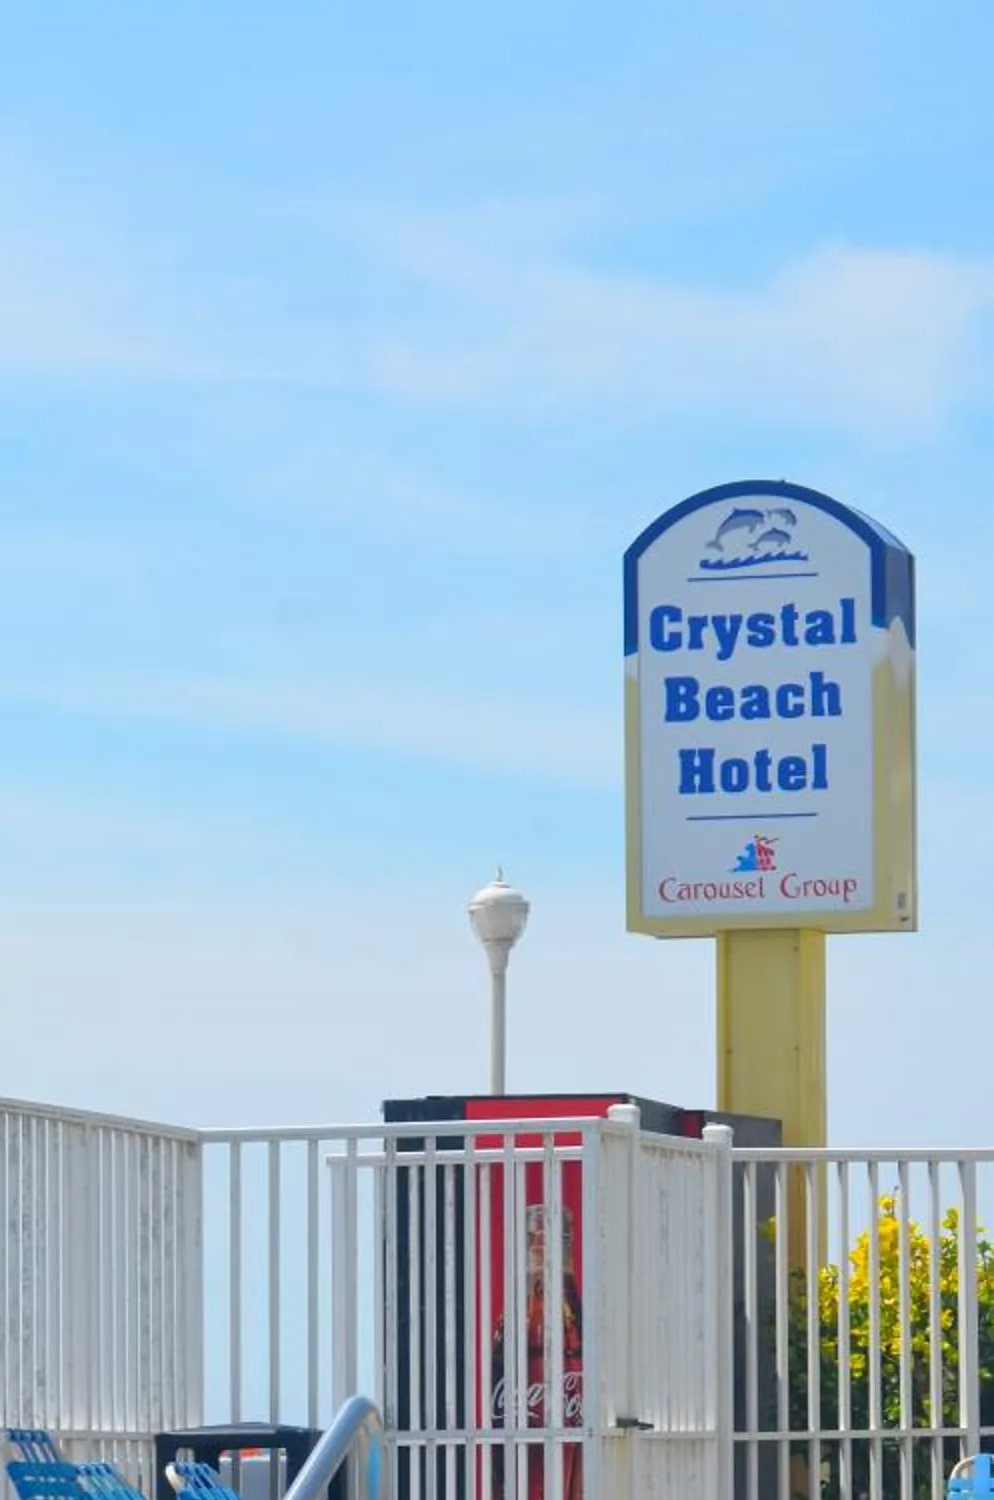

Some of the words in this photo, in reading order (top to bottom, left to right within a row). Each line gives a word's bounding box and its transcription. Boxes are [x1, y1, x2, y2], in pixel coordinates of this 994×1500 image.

[650, 598, 857, 661] Crystal
[664, 672, 841, 723] Beach
[679, 744, 829, 794] Hotel
[658, 877, 765, 903] Carousel
[780, 872, 858, 902] Group
